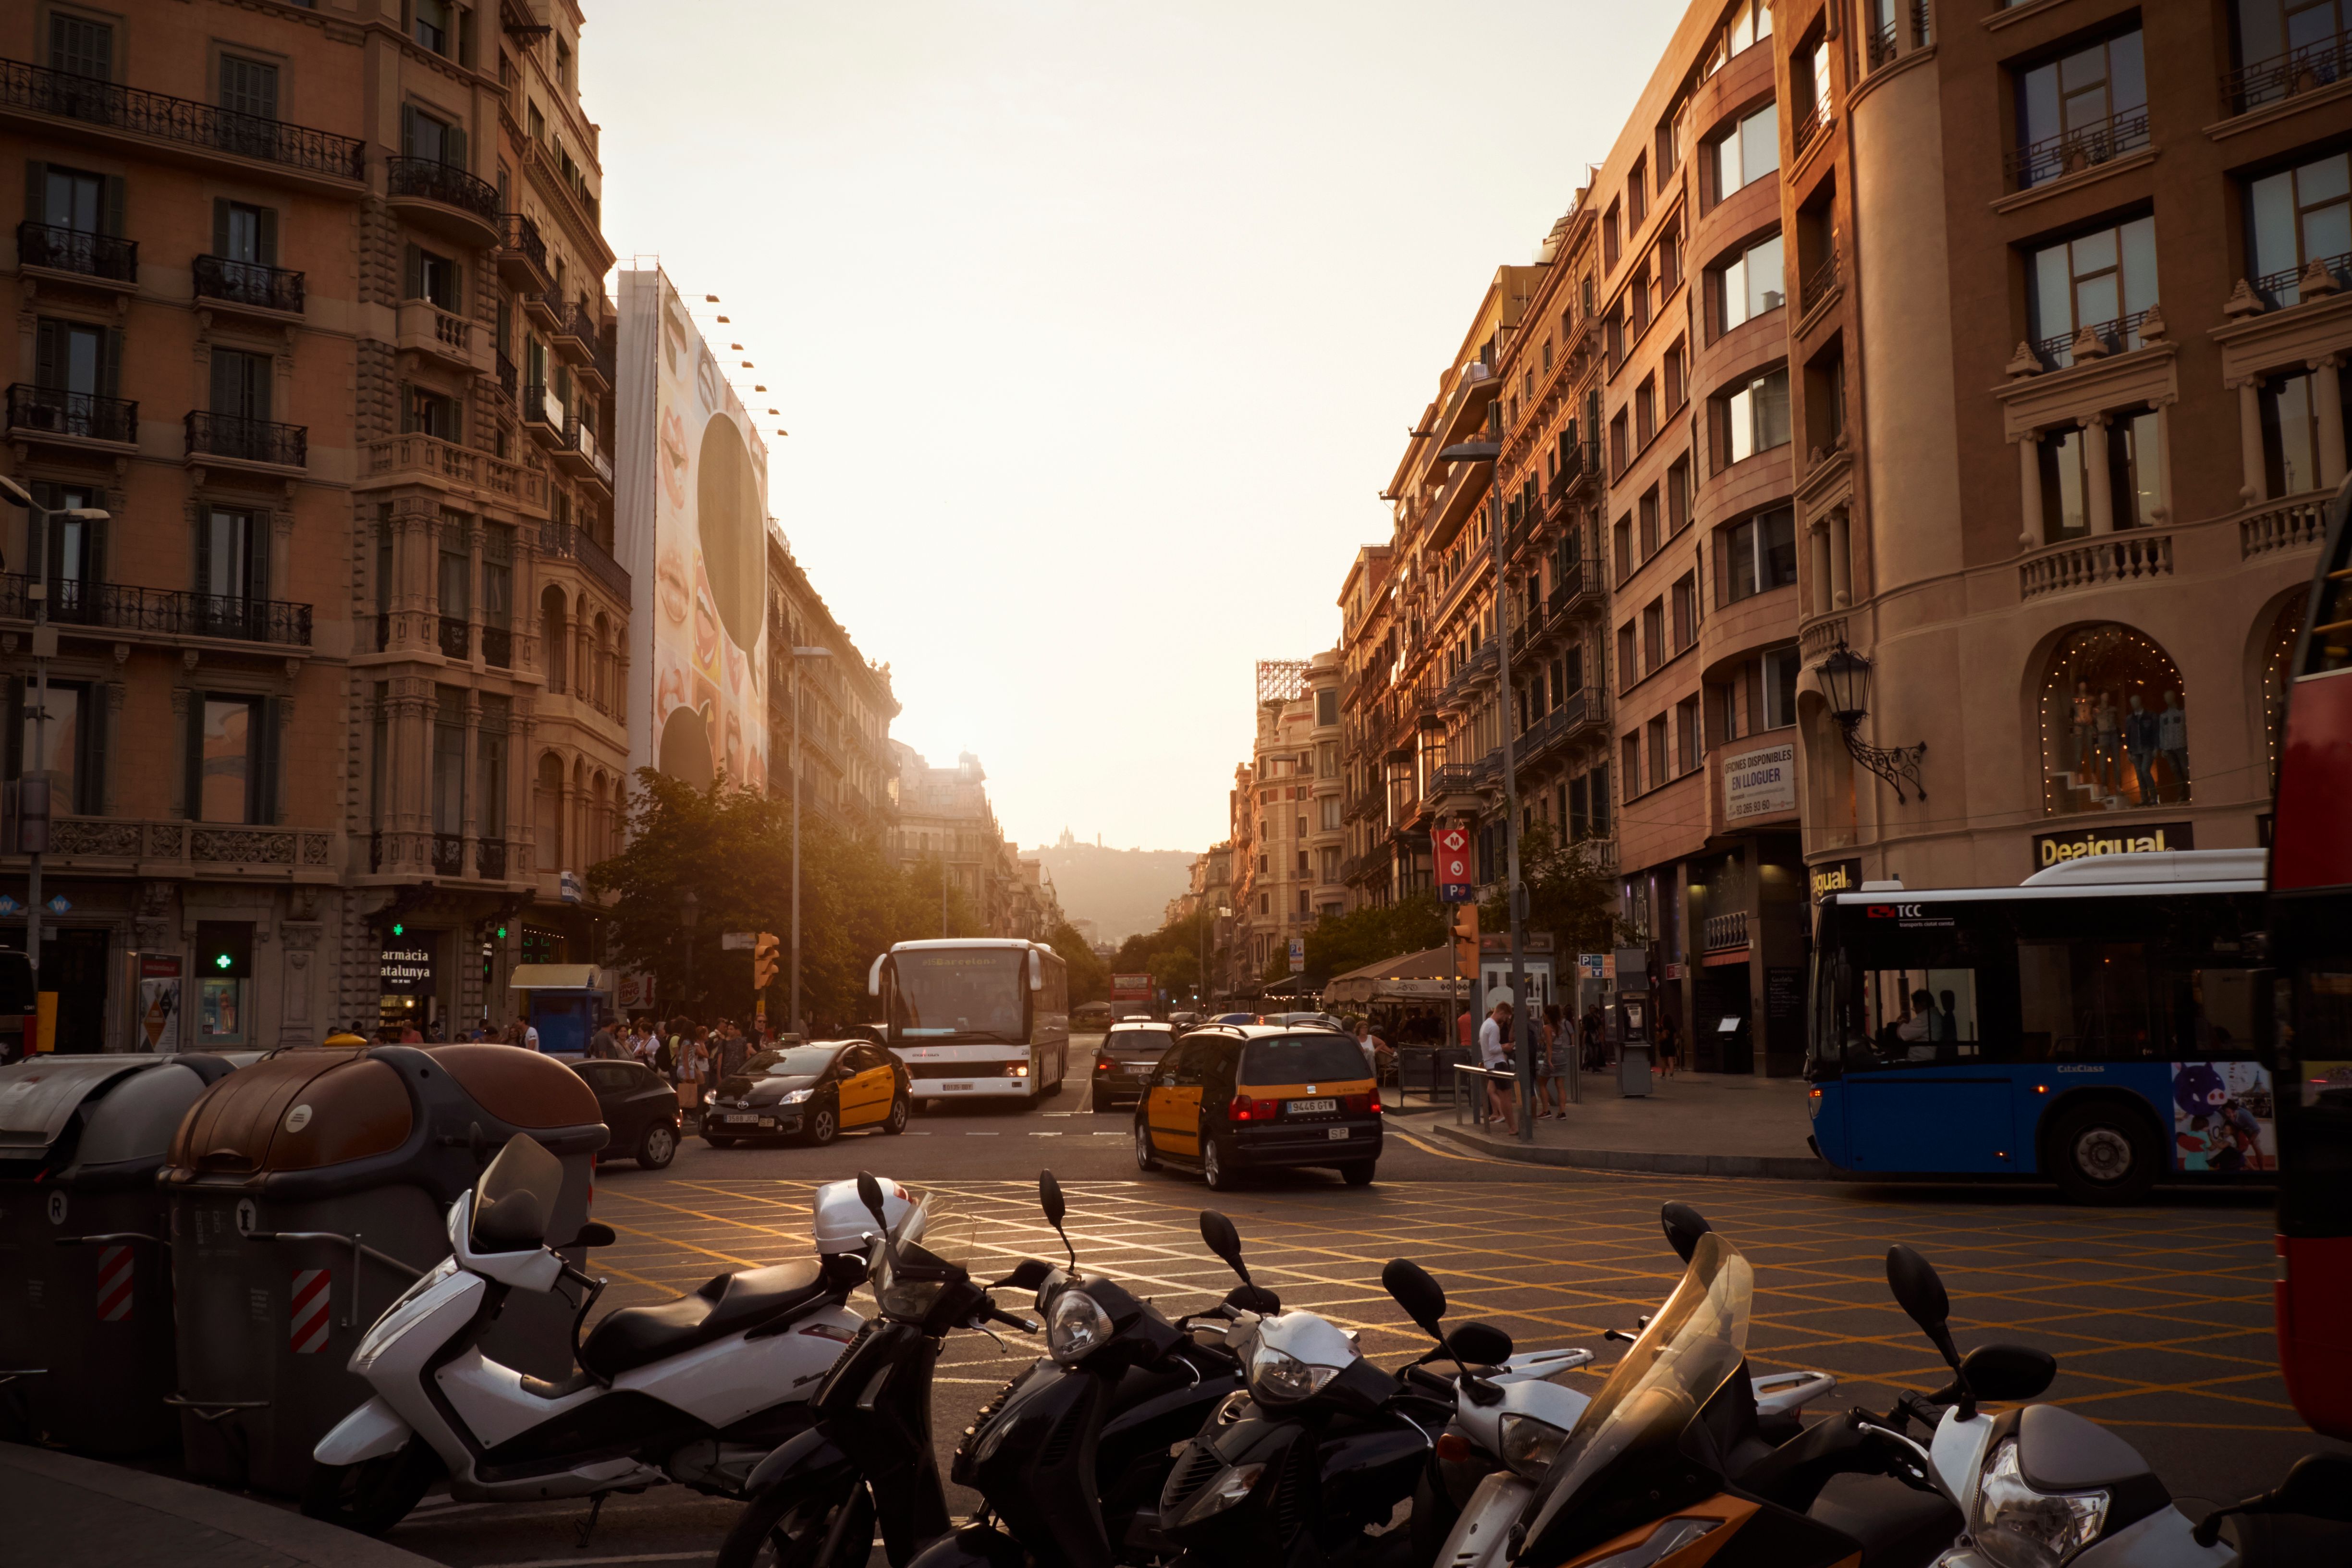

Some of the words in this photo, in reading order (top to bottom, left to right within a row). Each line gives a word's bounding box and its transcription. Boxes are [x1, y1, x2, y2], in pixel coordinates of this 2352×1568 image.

[1725, 759, 1746, 774] OFICINES
[1748, 749, 1791, 768] DISPONIBLES
[1732, 776, 1740, 790] EN
[1743, 768, 1780, 788] LLOGUER
[1737, 805, 1742, 815] 93
[1753, 801, 1760, 811] 93
[1762, 800, 1769, 810] 60
[1450, 837, 1459, 845] M
[1450, 885, 1458, 896] P
[53, 901, 66, 910] W
[1897, 905, 1922, 917] TCC
[382, 949, 429, 961] armàcia
[1582, 956, 1589, 965] P
[381, 965, 430, 980] atalunya
[619, 981, 638, 991] URGER
[1293, 1102, 1315, 1111] 9446
[1318, 1101, 1334, 1110] GTW
[1331, 1129, 1346, 1138] SP
[52, 1198, 61, 1217] R
